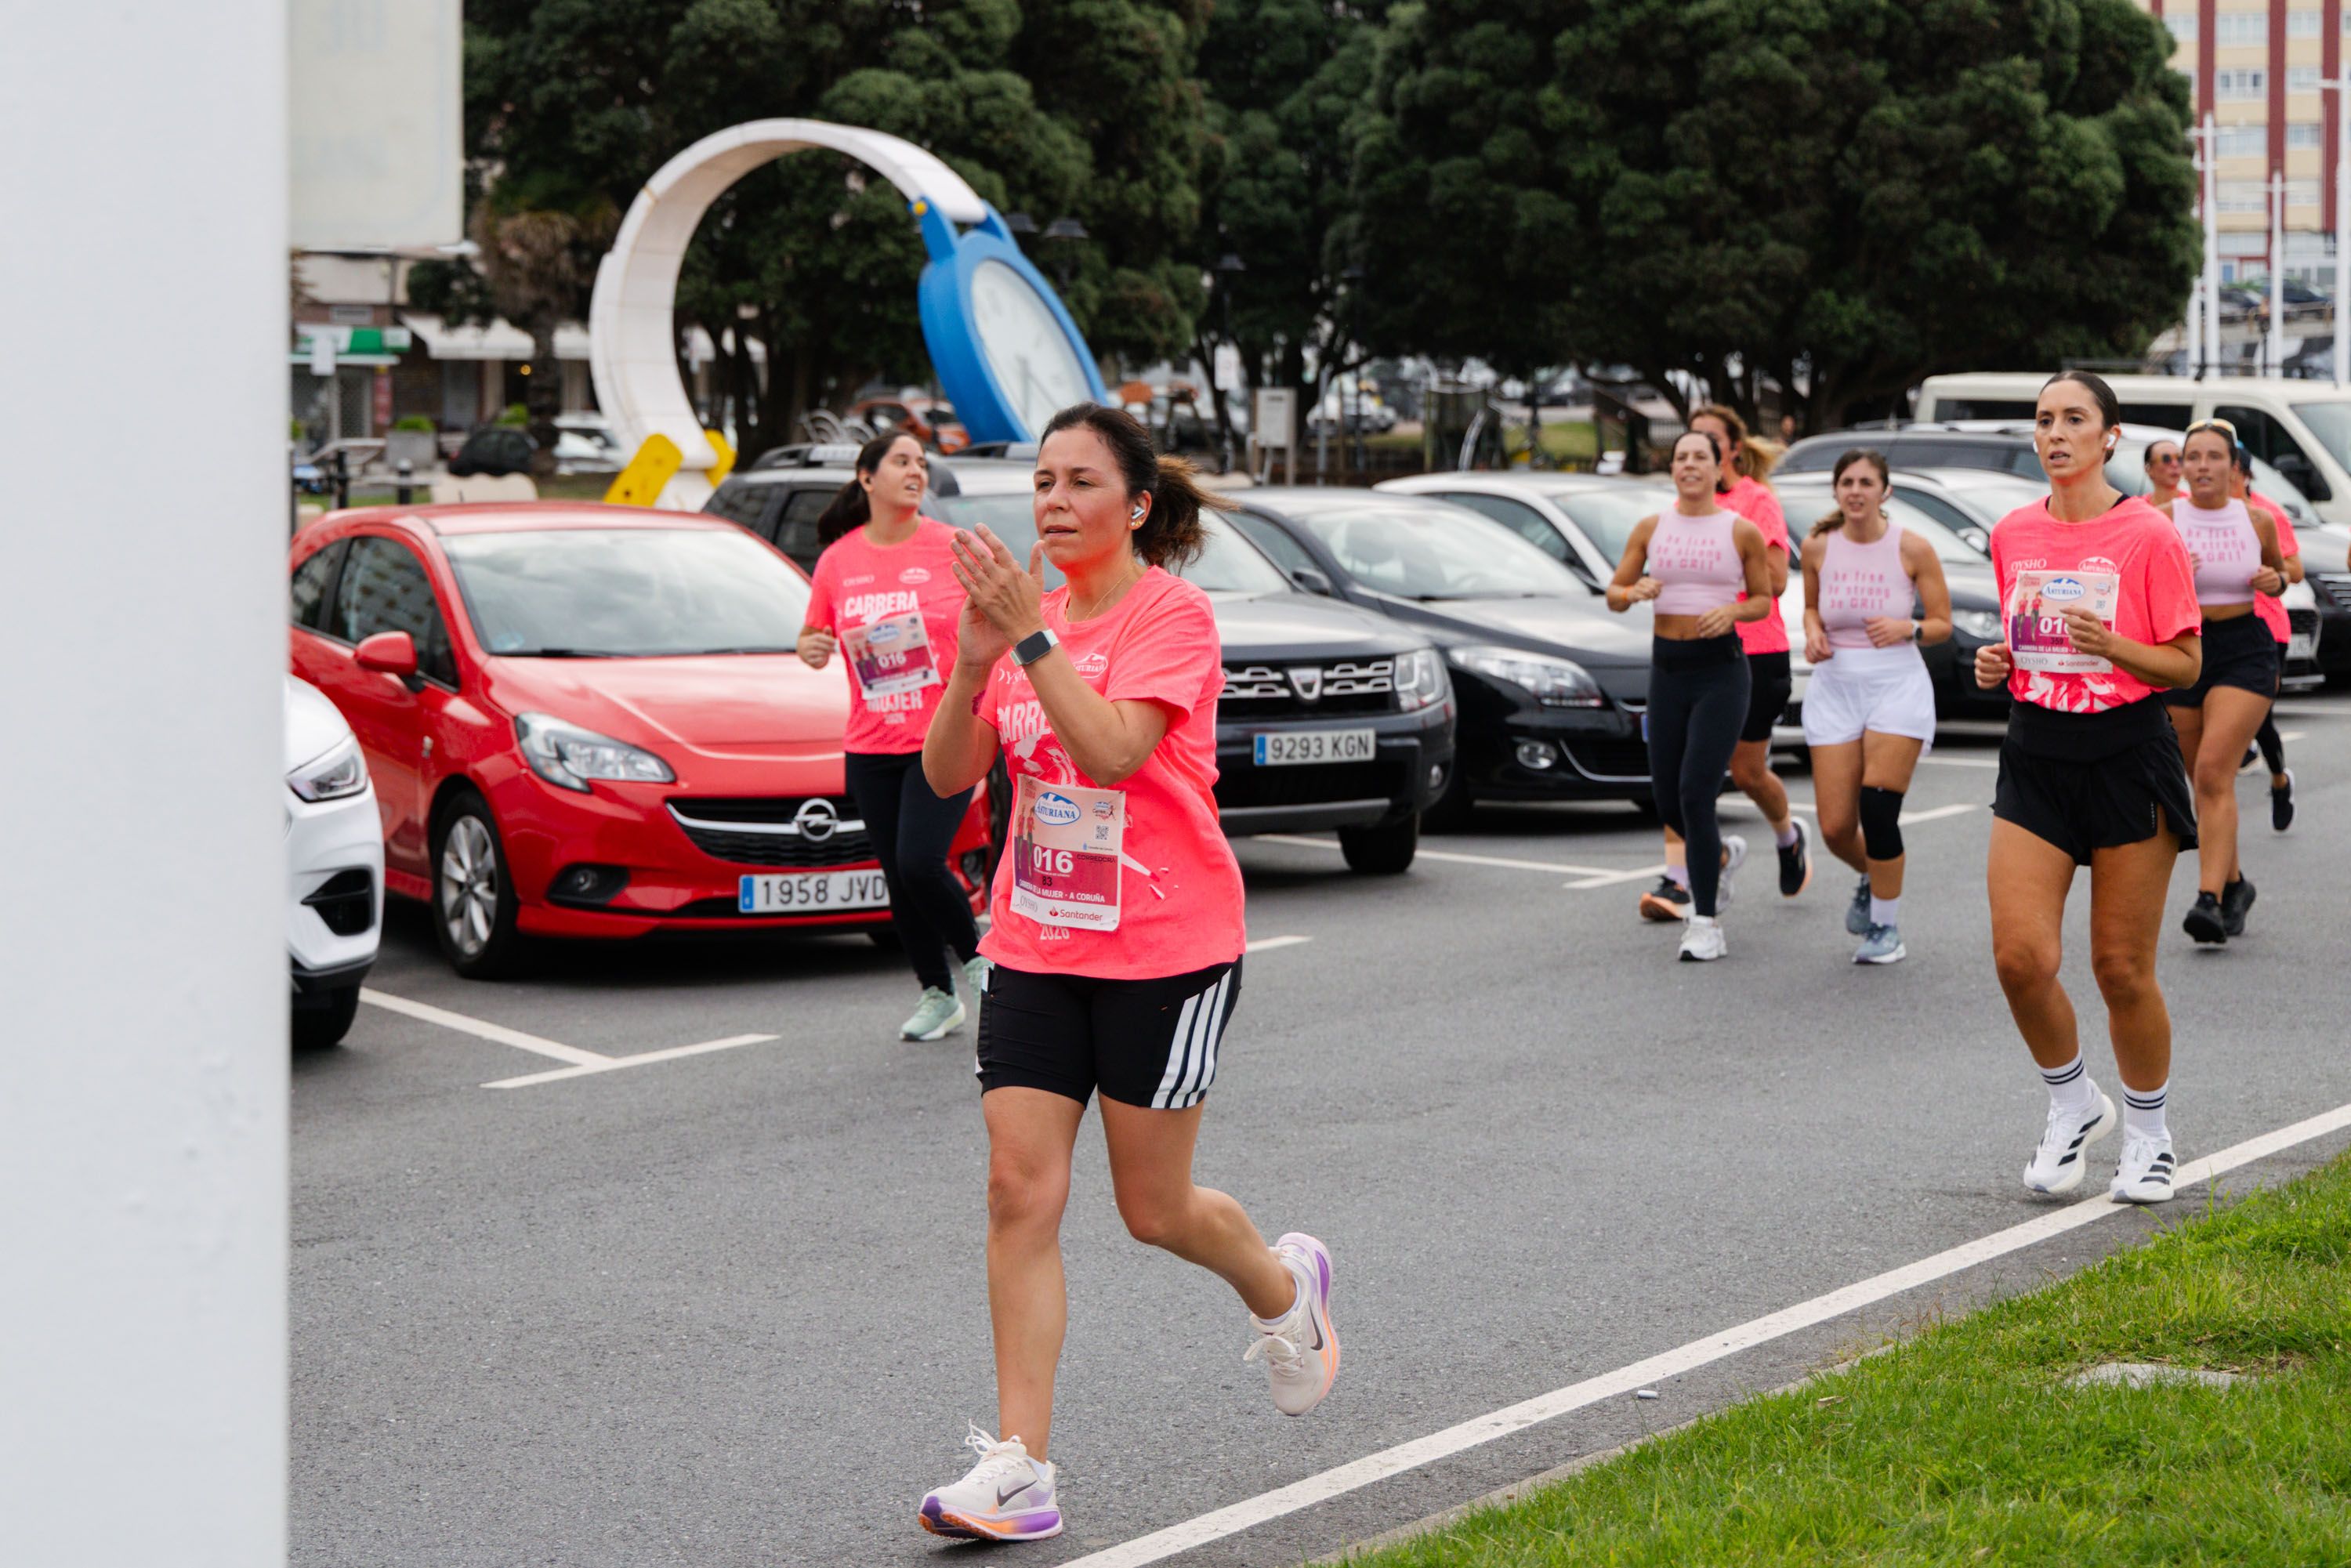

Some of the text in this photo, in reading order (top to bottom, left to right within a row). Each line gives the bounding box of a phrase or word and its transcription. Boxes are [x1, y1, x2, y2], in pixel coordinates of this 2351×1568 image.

[2011, 558, 2046, 571] OYSHO
[2047, 585, 2081, 596] ASTURIANA
[845, 591, 918, 617] CARRERA
[878, 651, 907, 668] 016
[1271, 733, 1370, 760] 9293 KGN
[1037, 803, 1076, 819] ASTURIANA
[1034, 846, 1074, 874] 016
[1042, 876, 1052, 886] 83
[763, 875, 886, 905] 1958 JVD
[1041, 889, 1063, 899] MUJER
[1076, 893, 1106, 903] CORUÑA
[1060, 909, 1103, 922] Santander
[1040, 925, 1069, 940] 2026
